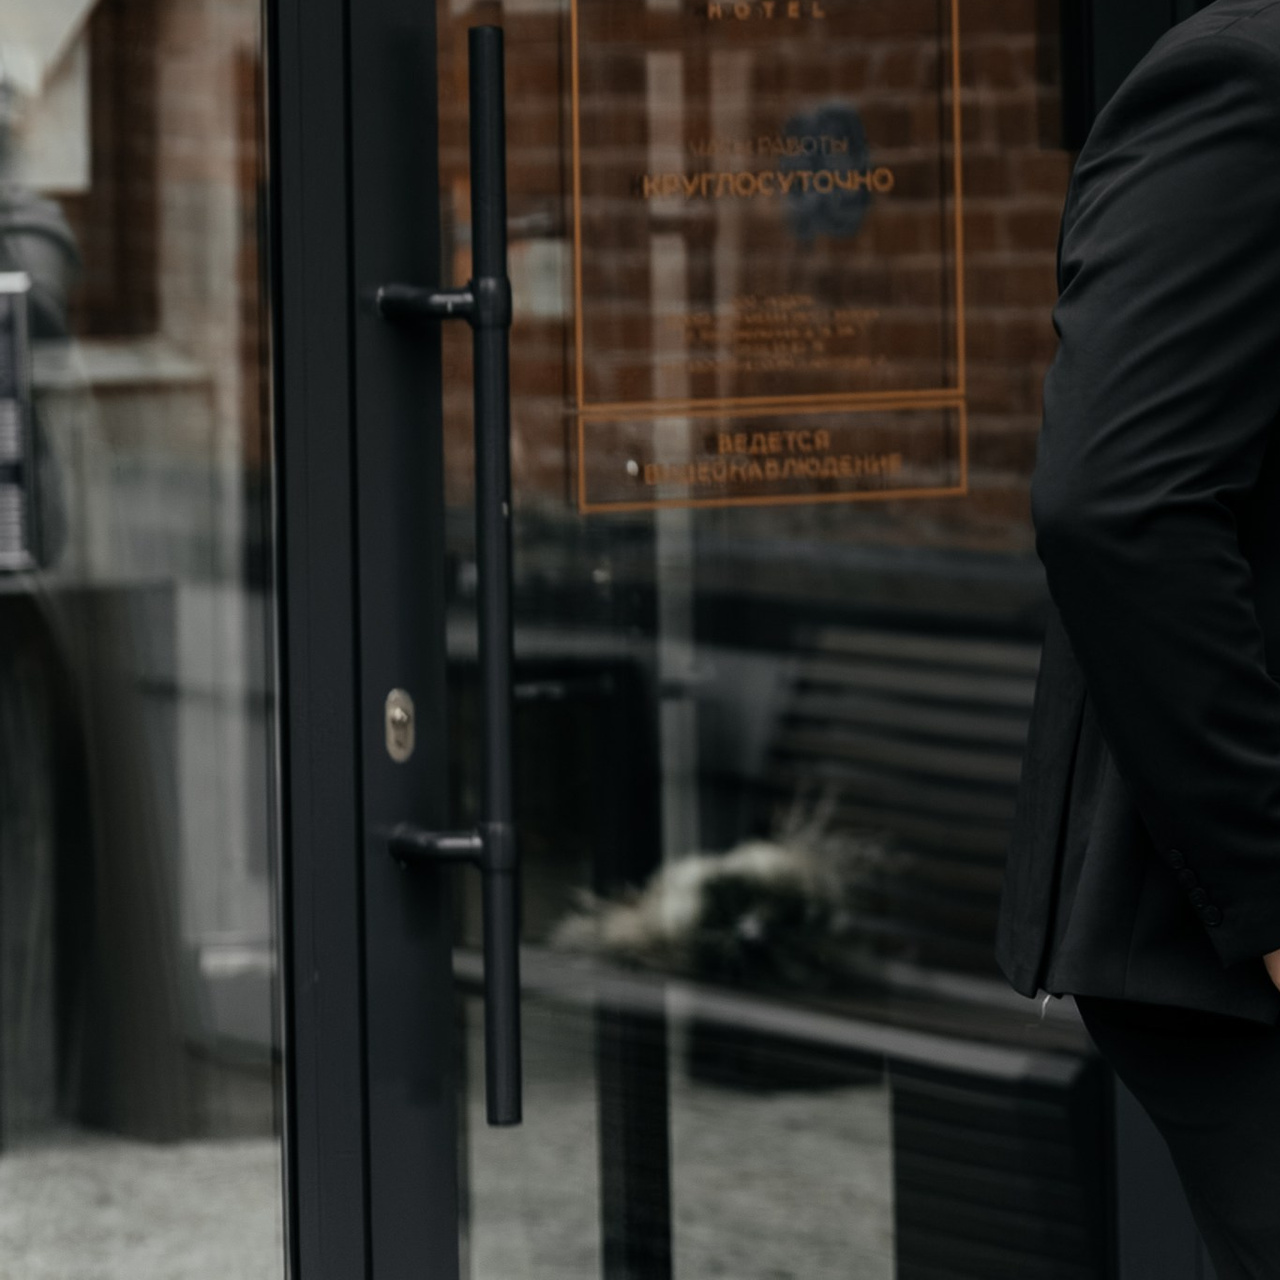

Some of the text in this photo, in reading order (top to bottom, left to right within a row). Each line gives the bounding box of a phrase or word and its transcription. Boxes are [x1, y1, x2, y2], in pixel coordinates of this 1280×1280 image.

[708, 0, 826, 21] HOTEL
[689, 134, 849, 159] ЧАЫ РАБОТЫ
[643, 166, 896, 200] КРУГЛОСУТОЧНО
[718, 430, 831, 455] ВЕДЕТСЯ
[644, 452, 903, 486] ВЕОНАБЛЮДЕНИЕ
